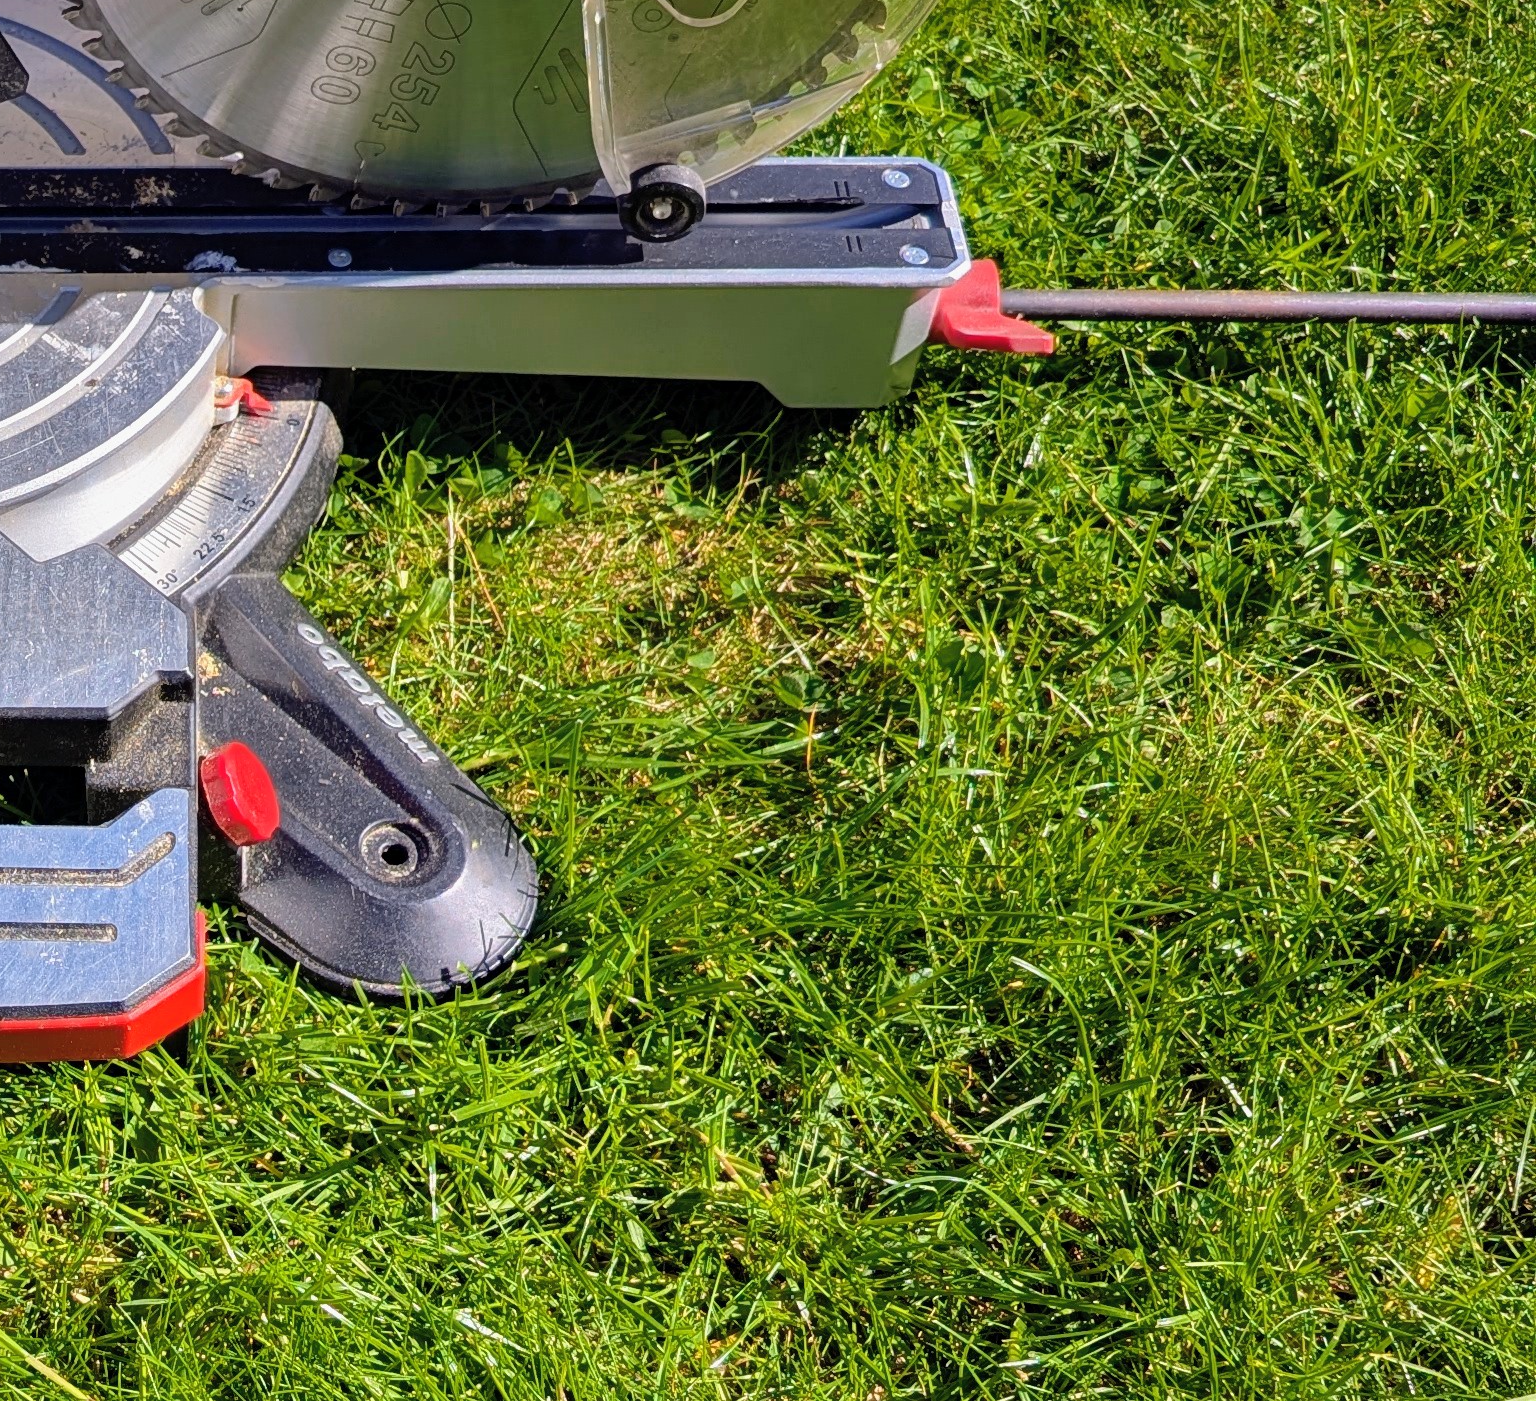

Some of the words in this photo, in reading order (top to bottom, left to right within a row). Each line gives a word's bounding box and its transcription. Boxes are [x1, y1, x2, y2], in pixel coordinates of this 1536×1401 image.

[310, 45, 376, 105] 60
[156, 568, 179, 590] 30°
[296, 622, 440, 763] metabo
